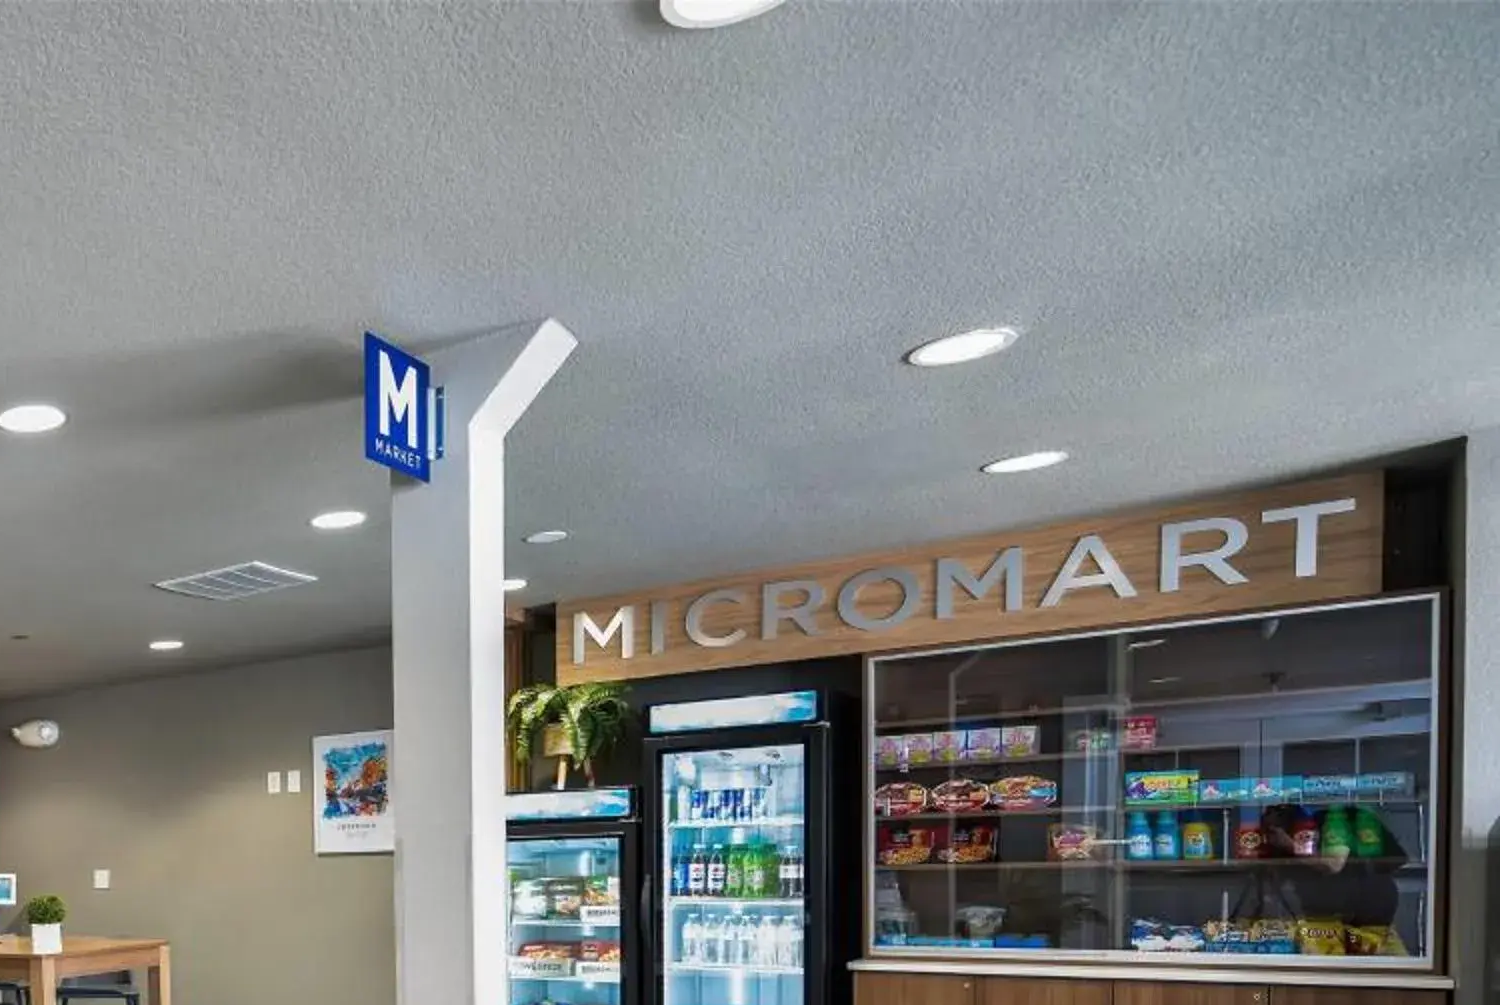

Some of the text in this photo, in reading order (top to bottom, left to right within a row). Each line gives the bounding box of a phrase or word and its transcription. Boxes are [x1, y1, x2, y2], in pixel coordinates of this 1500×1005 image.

[379, 349, 417, 449] M
[374, 437, 421, 469] MARKET
[572, 498, 1357, 665] MICROMART
